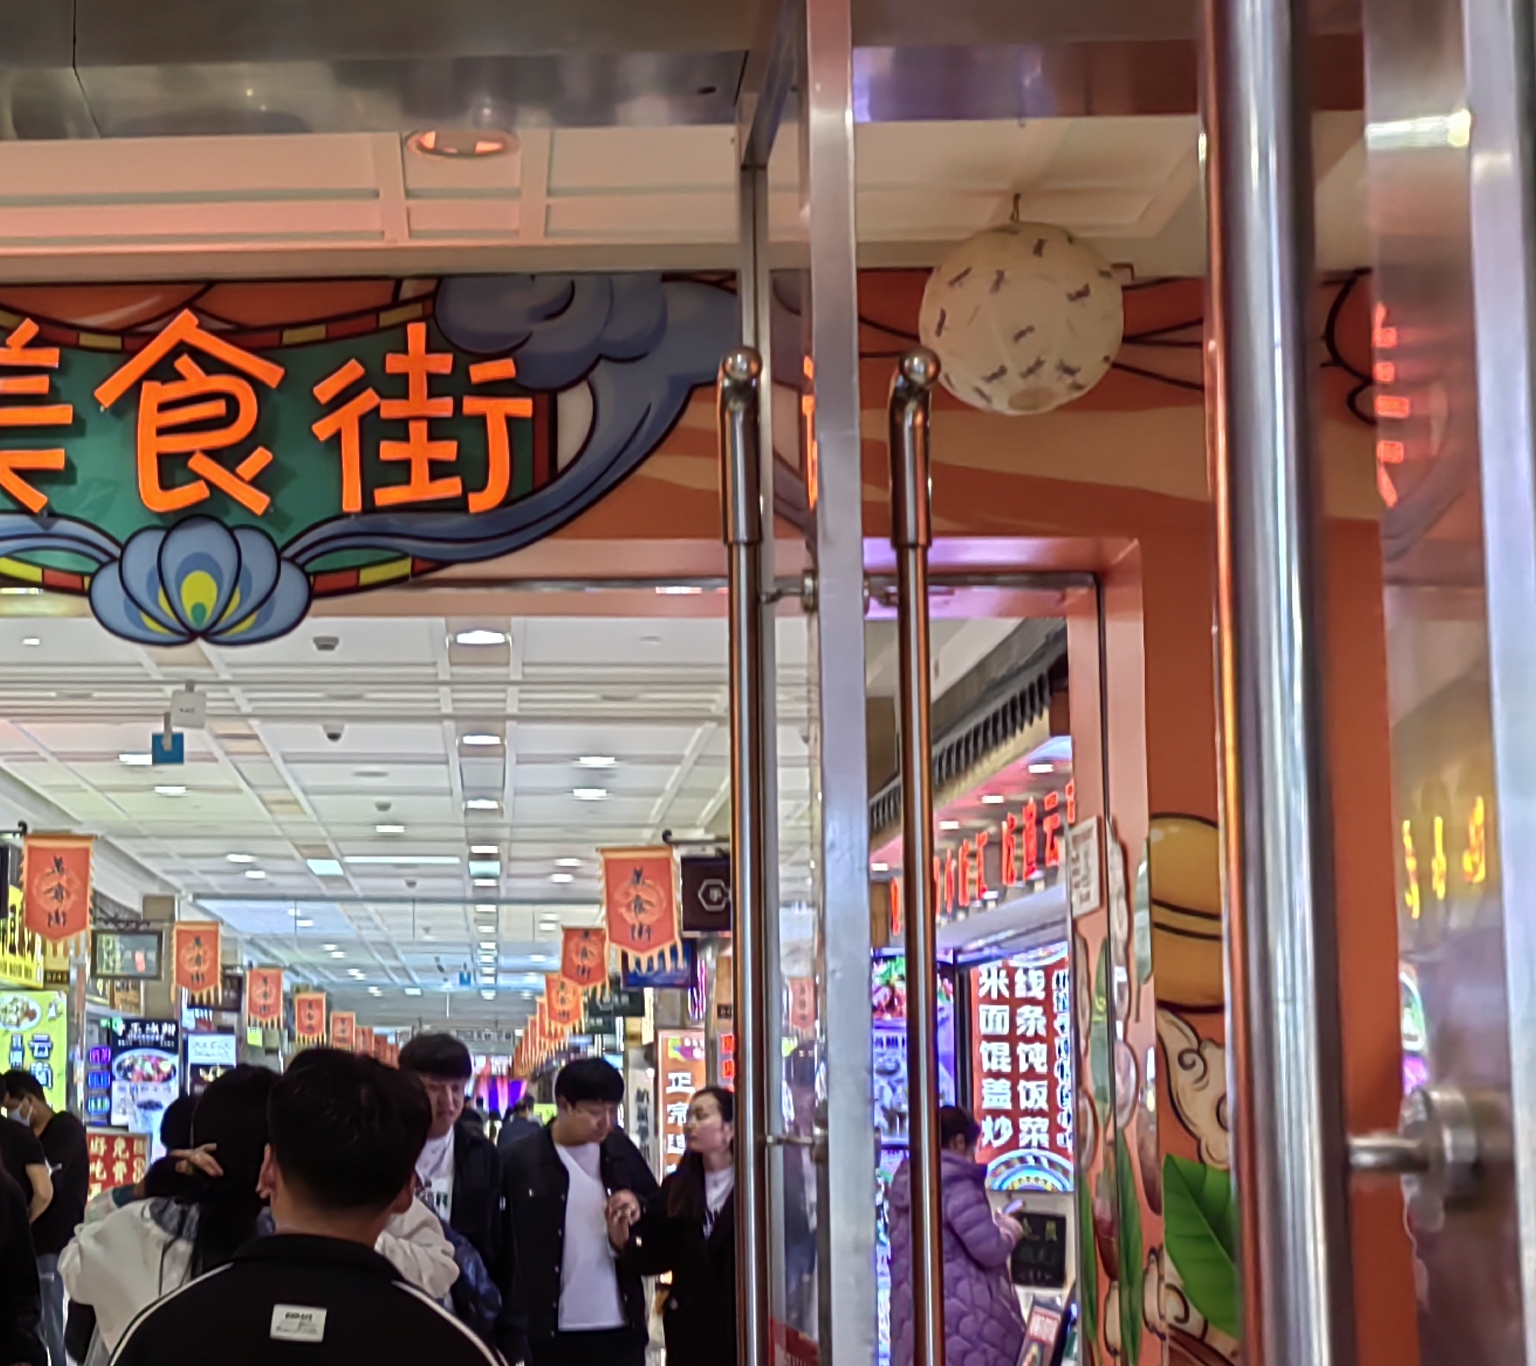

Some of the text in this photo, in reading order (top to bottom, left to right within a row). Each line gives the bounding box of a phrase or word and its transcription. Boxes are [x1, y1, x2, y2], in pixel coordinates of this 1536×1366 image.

[978, 963, 1047, 1001] 米线
[979, 1004, 1047, 1038] 面条
[980, 1040, 1049, 1074] 馄饨
[981, 1078, 1050, 1112] 盖饭
[981, 1115, 1051, 1149] 炒菜
